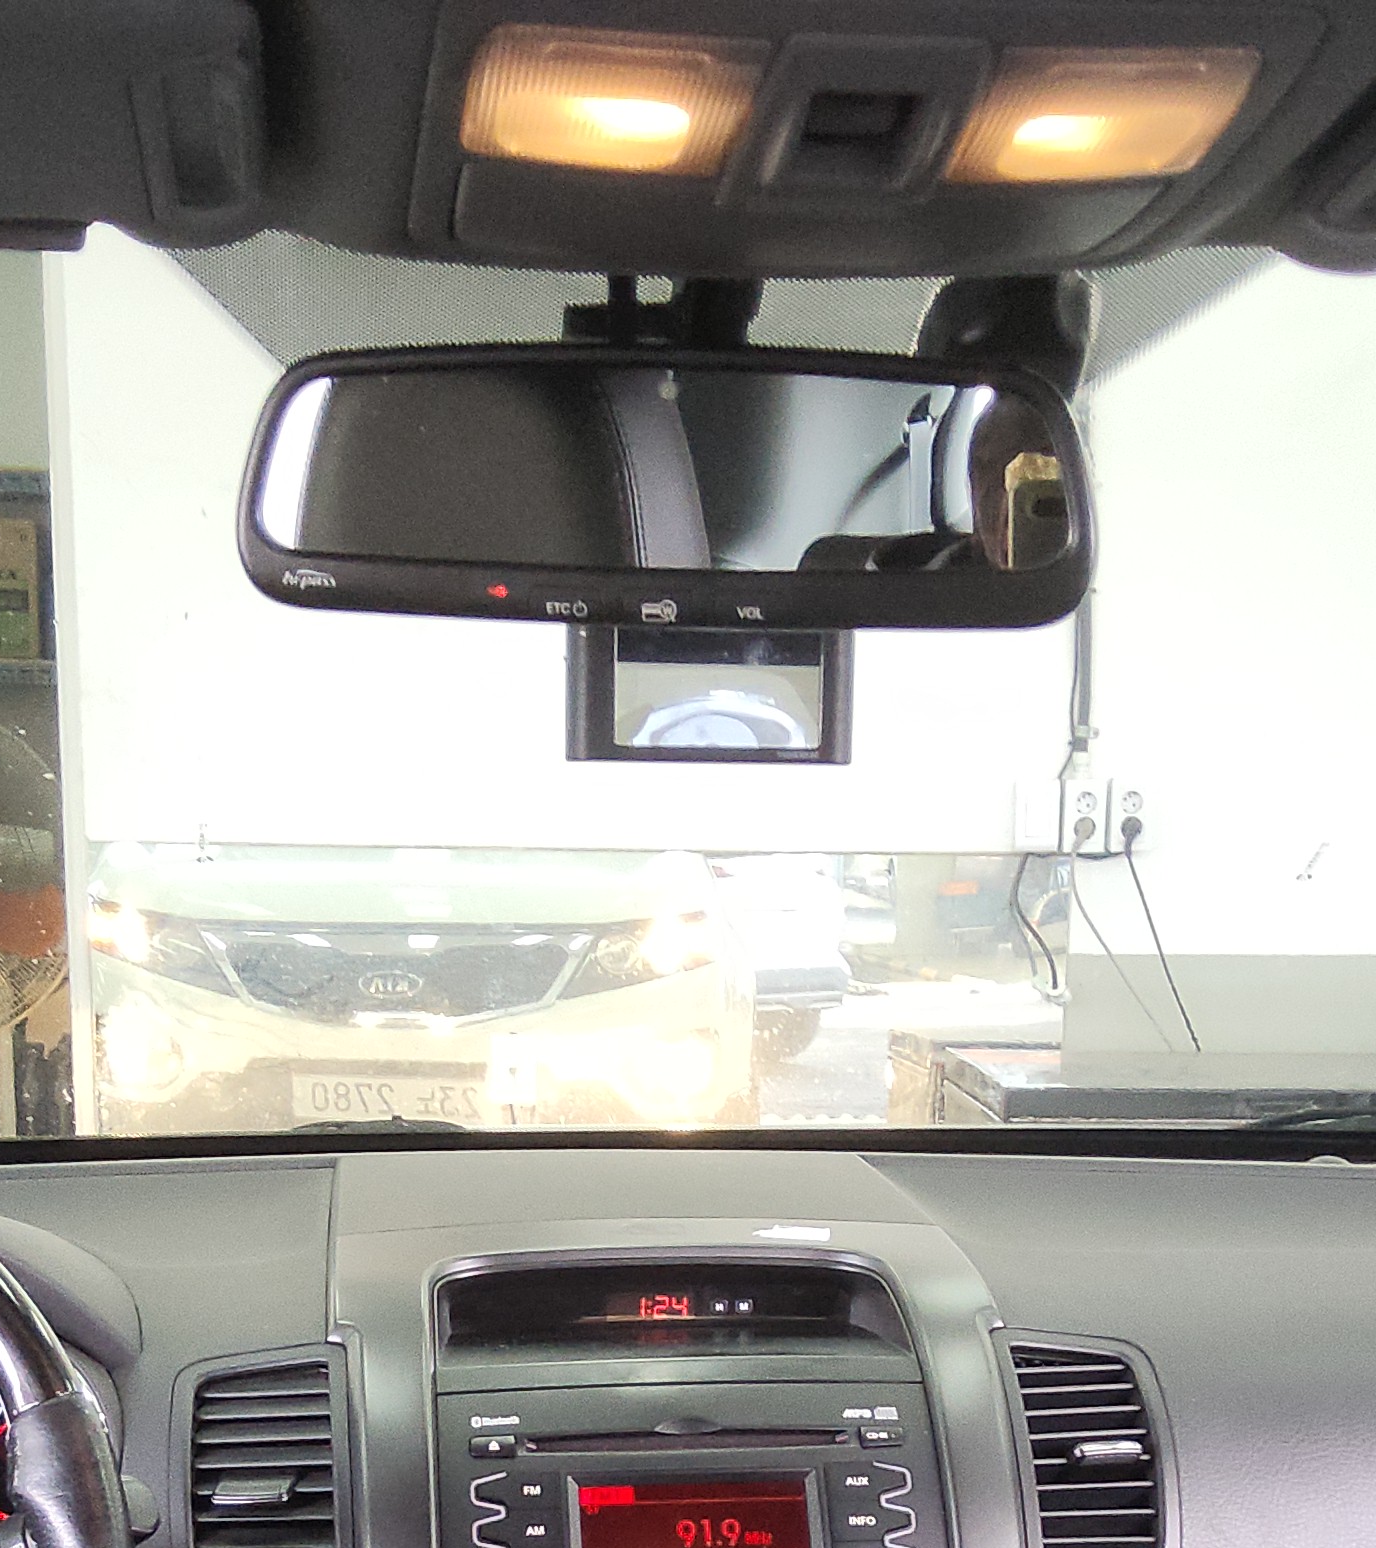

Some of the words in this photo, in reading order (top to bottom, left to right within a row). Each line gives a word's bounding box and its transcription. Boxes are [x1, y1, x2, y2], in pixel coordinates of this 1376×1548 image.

[545, 601, 570, 614] ETC
[736, 606, 764, 619] VOL
[639, 1295, 689, 1318] 1:24
[845, 1476, 870, 1486] AUX
[523, 1485, 541, 1496] FM
[848, 1516, 877, 1526] INFO
[525, 1525, 546, 1537] AM
[675, 1518, 741, 1548] 91.9
